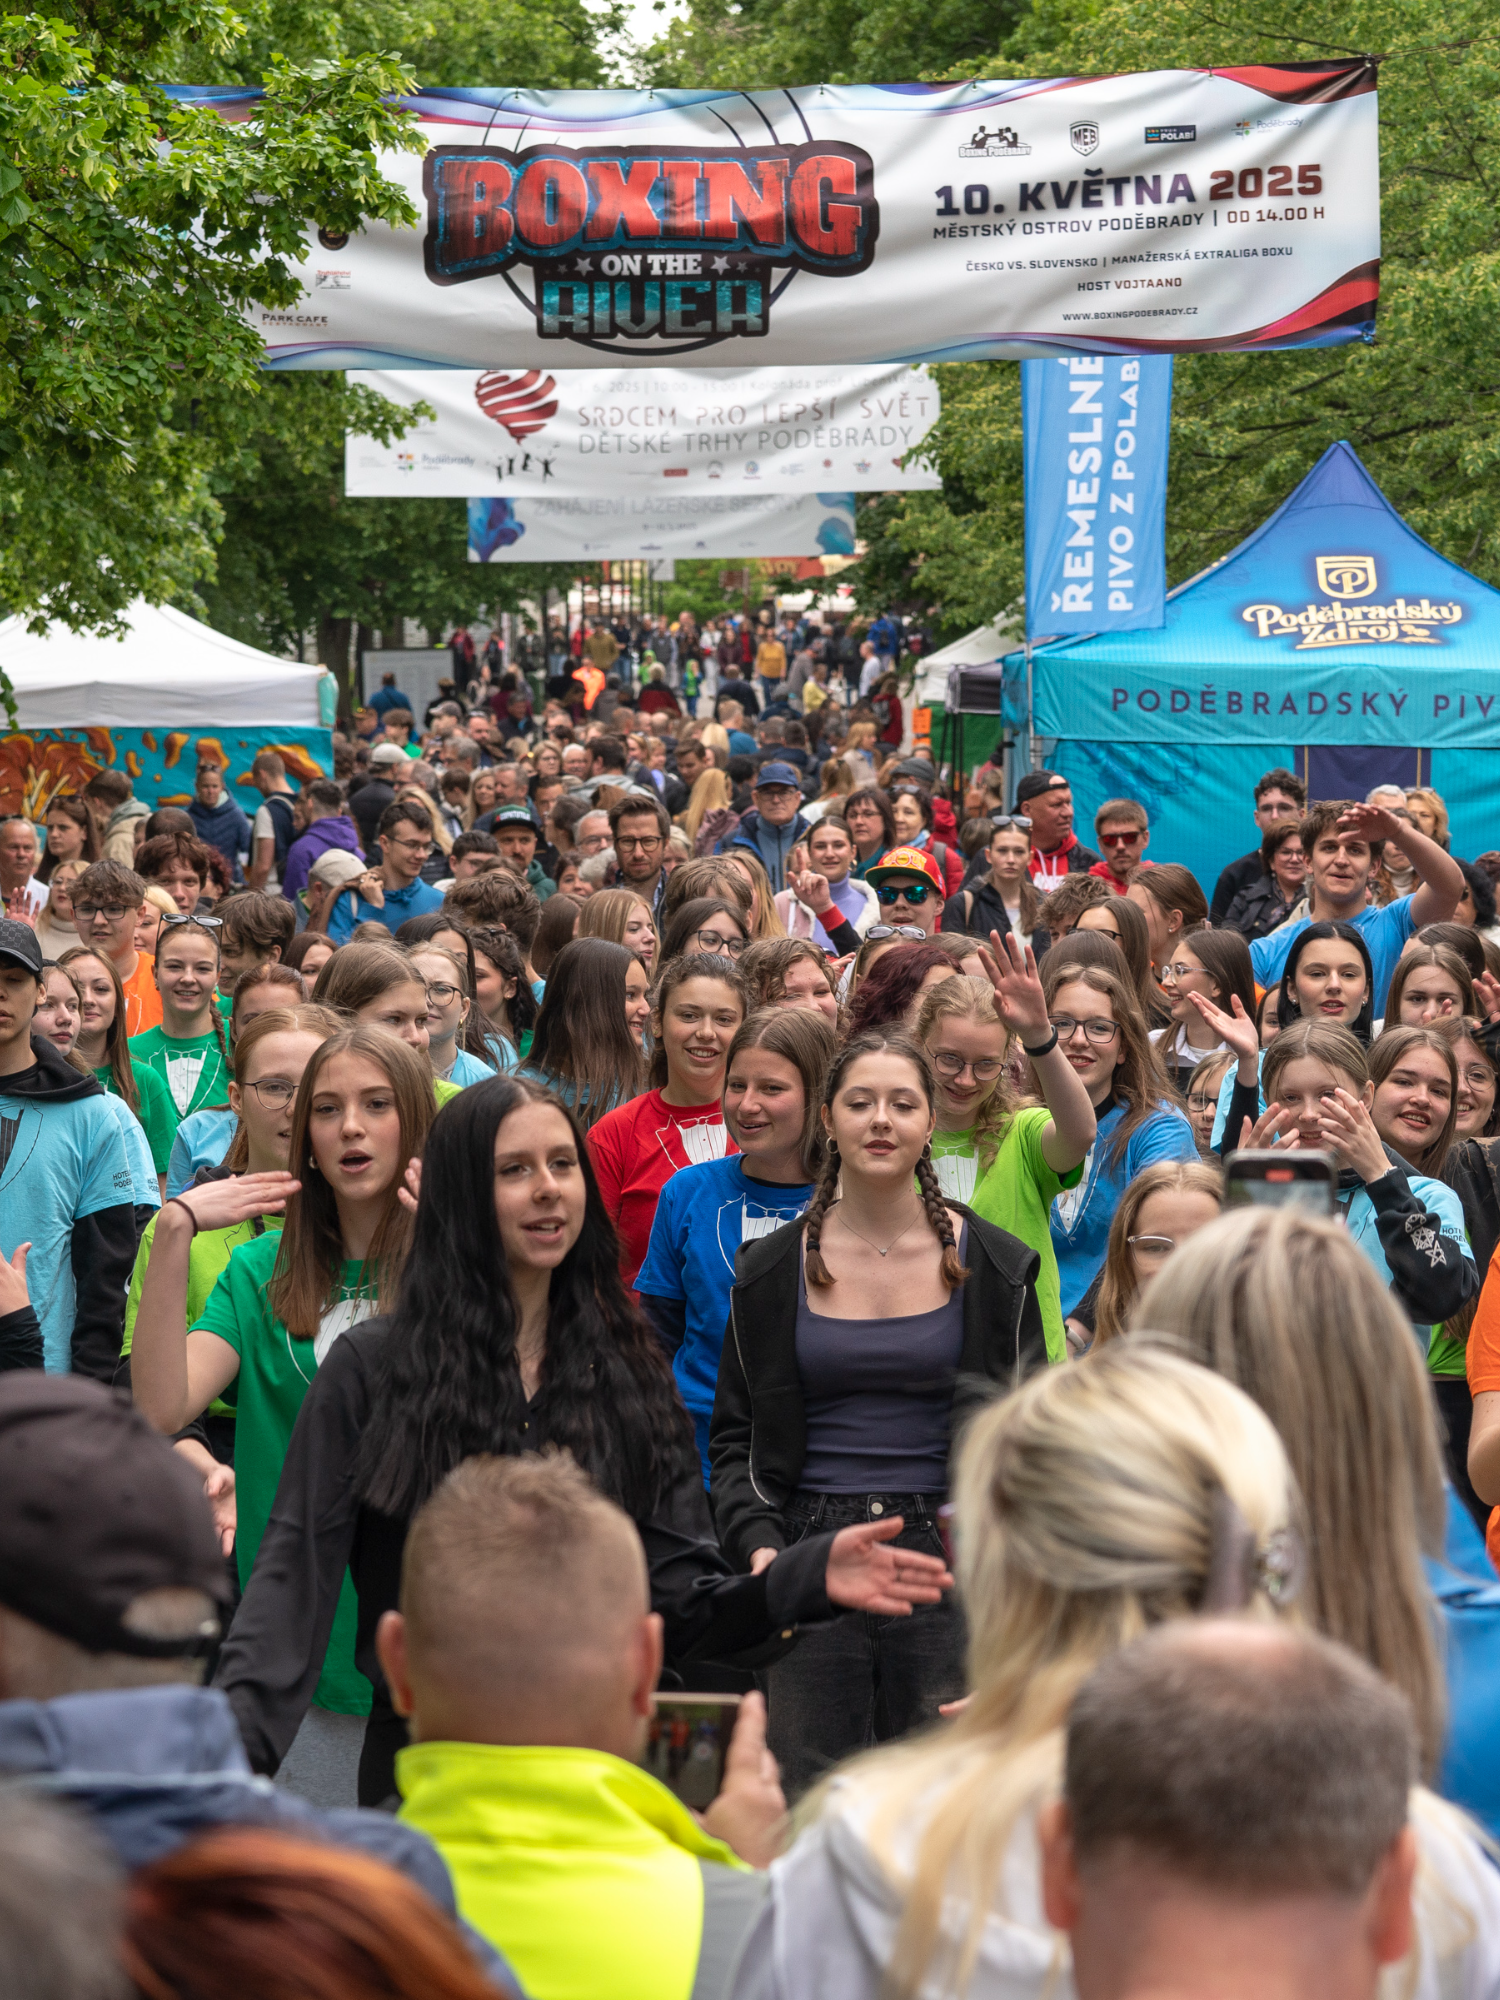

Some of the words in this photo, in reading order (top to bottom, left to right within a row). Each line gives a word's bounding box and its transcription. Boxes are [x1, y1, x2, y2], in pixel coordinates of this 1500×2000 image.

[1160, 130, 1195, 141] POLABÍ
[934, 183, 1006, 217] 10.
[1018, 168, 1197, 213] KVĚTNA
[1208, 163, 1323, 201] 2025
[441, 153, 865, 274] BOXING
[932, 219, 1017, 240] MĚSTSKÝ
[1022, 220, 1093, 236] OSTROV
[1098, 212, 1204, 232] PODĚBRADY
[1227, 210, 1250, 224] OD
[1256, 207, 1309, 223] 14.00
[1313, 206, 1325, 220] H
[600, 254, 643, 277] ON
[646, 254, 703, 276] THE
[966, 260, 1004, 272] ČESKO
[1007, 260, 1027, 270] VS.
[1029, 257, 1098, 270] SLOVENSKO
[1111, 249, 1192, 265] MANAŽERSKÁ
[1194, 247, 1259, 260] EXTRALIGA
[1261, 246, 1294, 258] BOXU
[1077, 280, 1111, 292] HOST
[1113, 277, 1183, 290] VOJTAANO
[262, 313, 293, 322] PARK
[541, 280, 764, 335] RIVER
[1062, 307, 1199, 322] WWW.BOXINGPODEBRADY.CZ
[578, 405, 677, 427] SRDCEM
[695, 405, 747, 427] PRO
[762, 397, 837, 424] LEPŠÍ
[859, 391, 930, 419] SVĚT
[1111, 355, 1141, 480] POLAB
[578, 431, 672, 454] DĚTSKÉ
[682, 432, 748, 453] TRHY
[757, 425, 914, 450] PODĚBRADY
[1109, 493, 1134, 515] Z
[1107, 525, 1135, 612] PIVO
[1242, 598, 1463, 638] Poděbradský
[1300, 620, 1400, 645] Zdroj
[1111, 684, 1409, 717] PODĚBRADSKÝ
